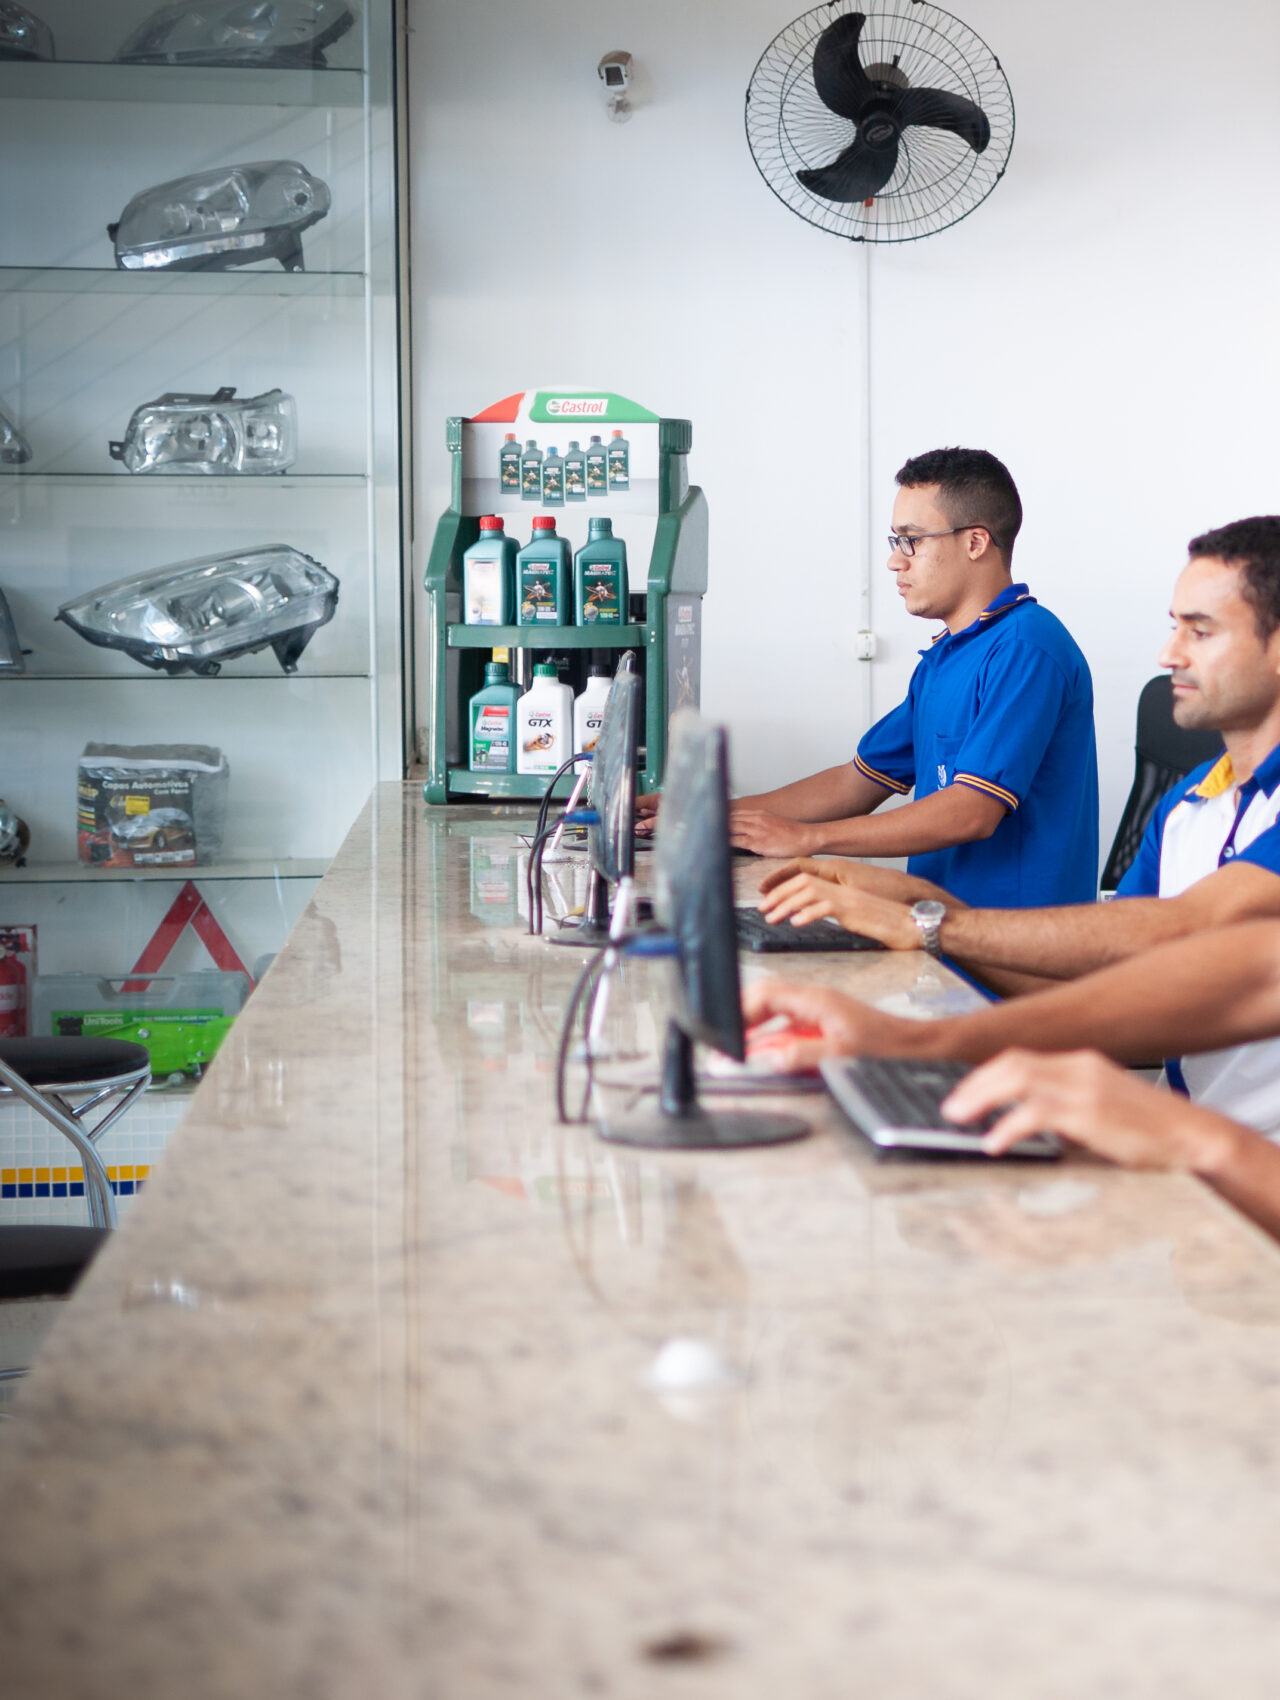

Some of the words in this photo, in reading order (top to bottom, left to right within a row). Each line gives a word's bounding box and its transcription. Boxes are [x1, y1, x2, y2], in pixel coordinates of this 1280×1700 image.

[561, 400, 604, 414] Castrol
[528, 718, 552, 727] GTX
[586, 719, 602, 728] GT
[102, 780, 130, 790] Capas
[132, 781, 189, 789] Automotivas
